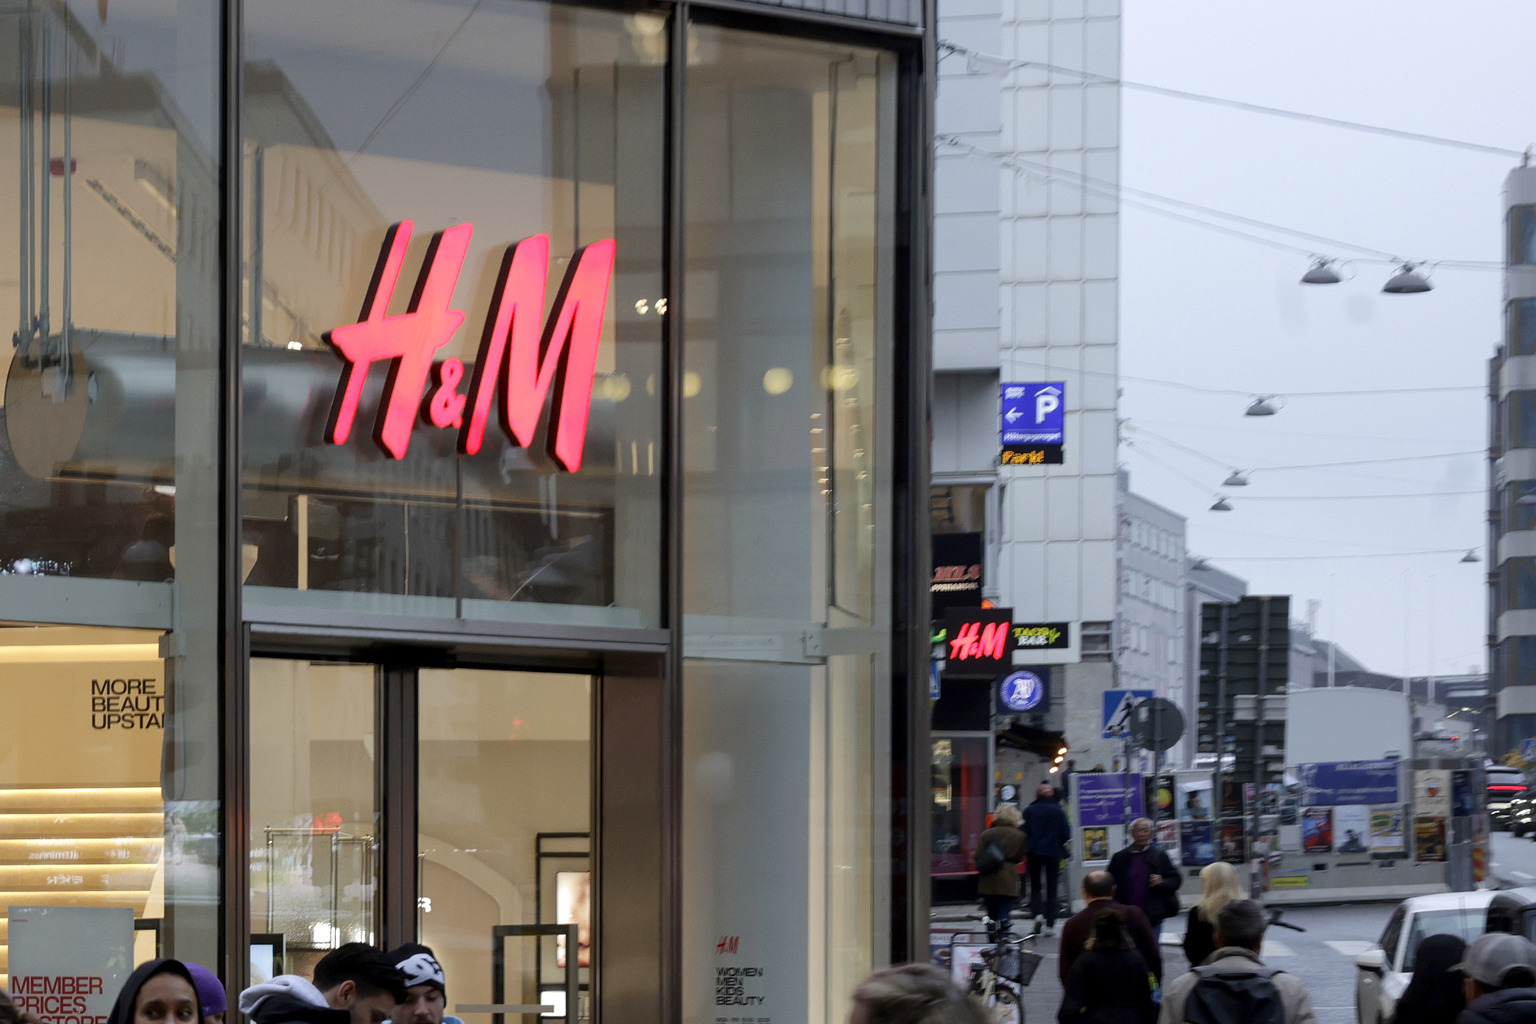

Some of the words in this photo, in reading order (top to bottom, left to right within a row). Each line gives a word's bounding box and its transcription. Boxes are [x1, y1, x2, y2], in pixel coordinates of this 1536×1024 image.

[322, 219, 616, 474] H&M
[949, 621, 1010, 661] H&M
[91, 678, 157, 695] MORE
[91, 696, 165, 712] BEAUT
[716, 967, 764, 977] WOMEN
[12, 976, 103, 994] MEMBER
[716, 977, 743, 986] MEN
[716, 987, 744, 996] KIDS
[12, 996, 87, 1014] PRICES
[716, 996, 765, 1006] BEAUTY
